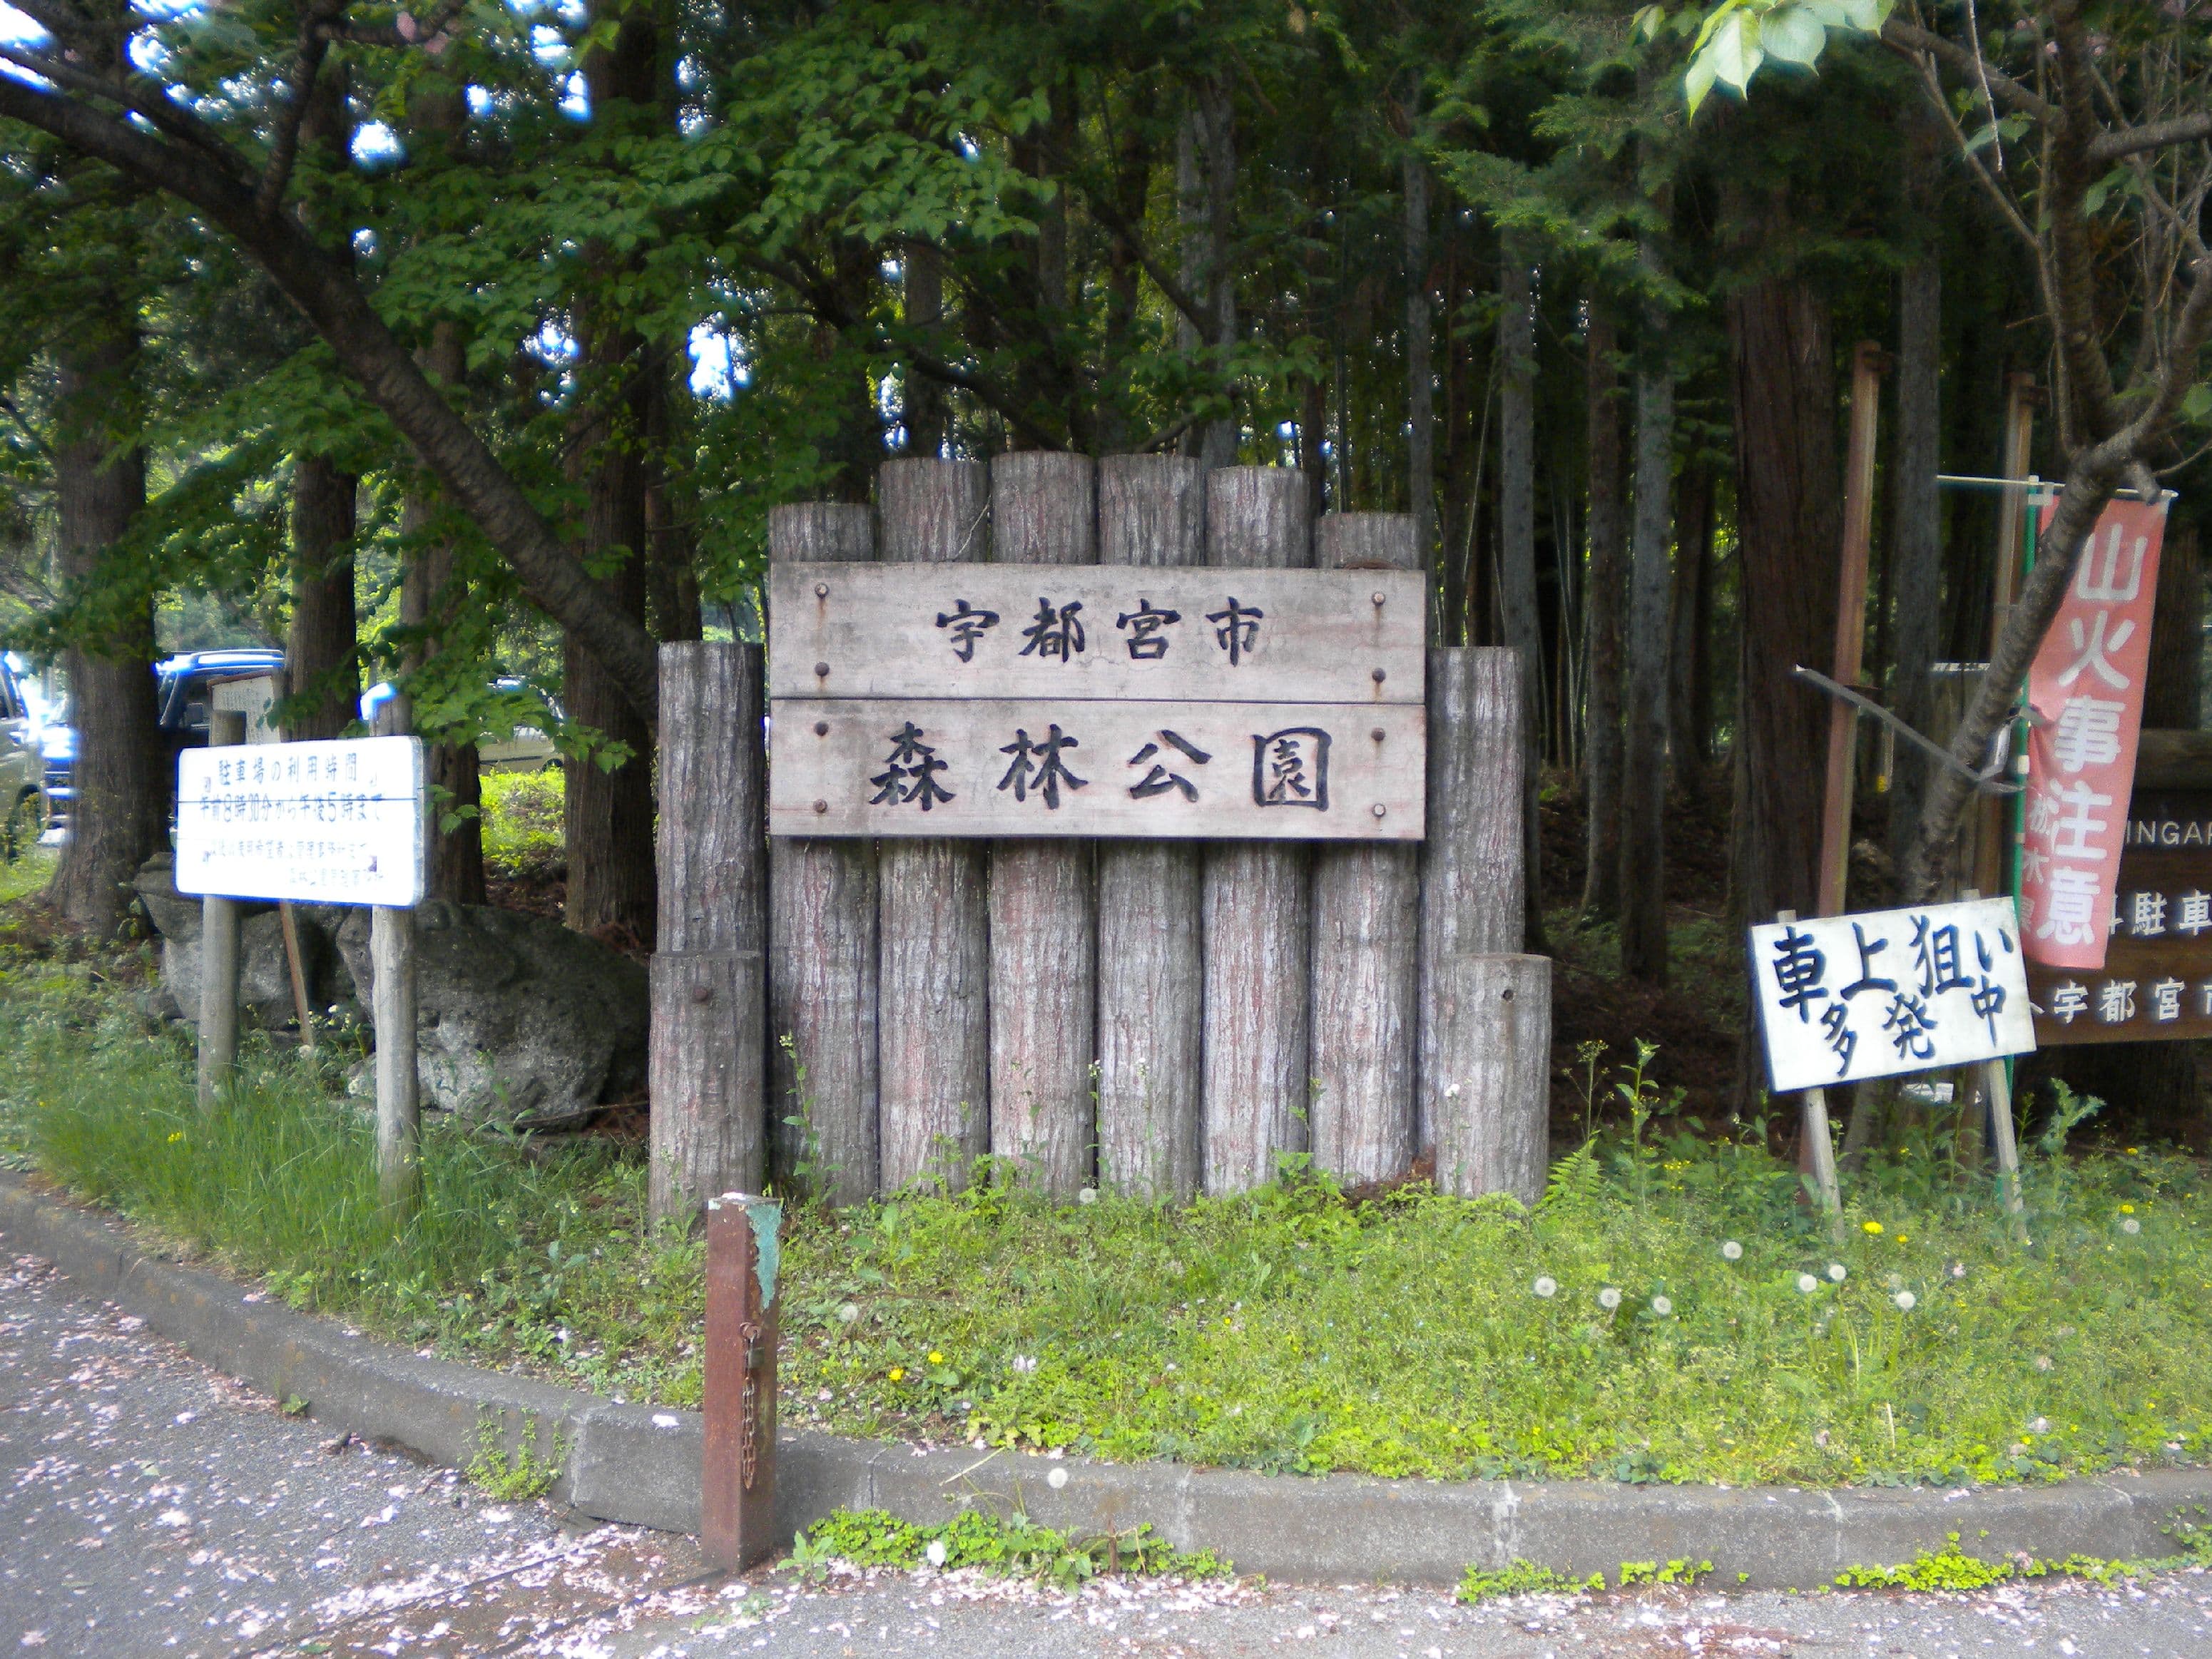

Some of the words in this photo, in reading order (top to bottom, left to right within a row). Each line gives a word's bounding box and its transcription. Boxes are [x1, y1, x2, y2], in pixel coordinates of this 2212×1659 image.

[936, 596, 1265, 667] 宇都宮市
[218, 752, 357, 785] 駐車場の利用時間
[870, 721, 1333, 812] 森林公園
[2037, 523, 2148, 945] 山火事注意
[2126, 820, 2212, 845] INGA
[1773, 914, 2014, 1024] 車上狙い
[2054, 976, 2212, 1024] 宇都宮
[1820, 975, 2007, 1078] 多発中
